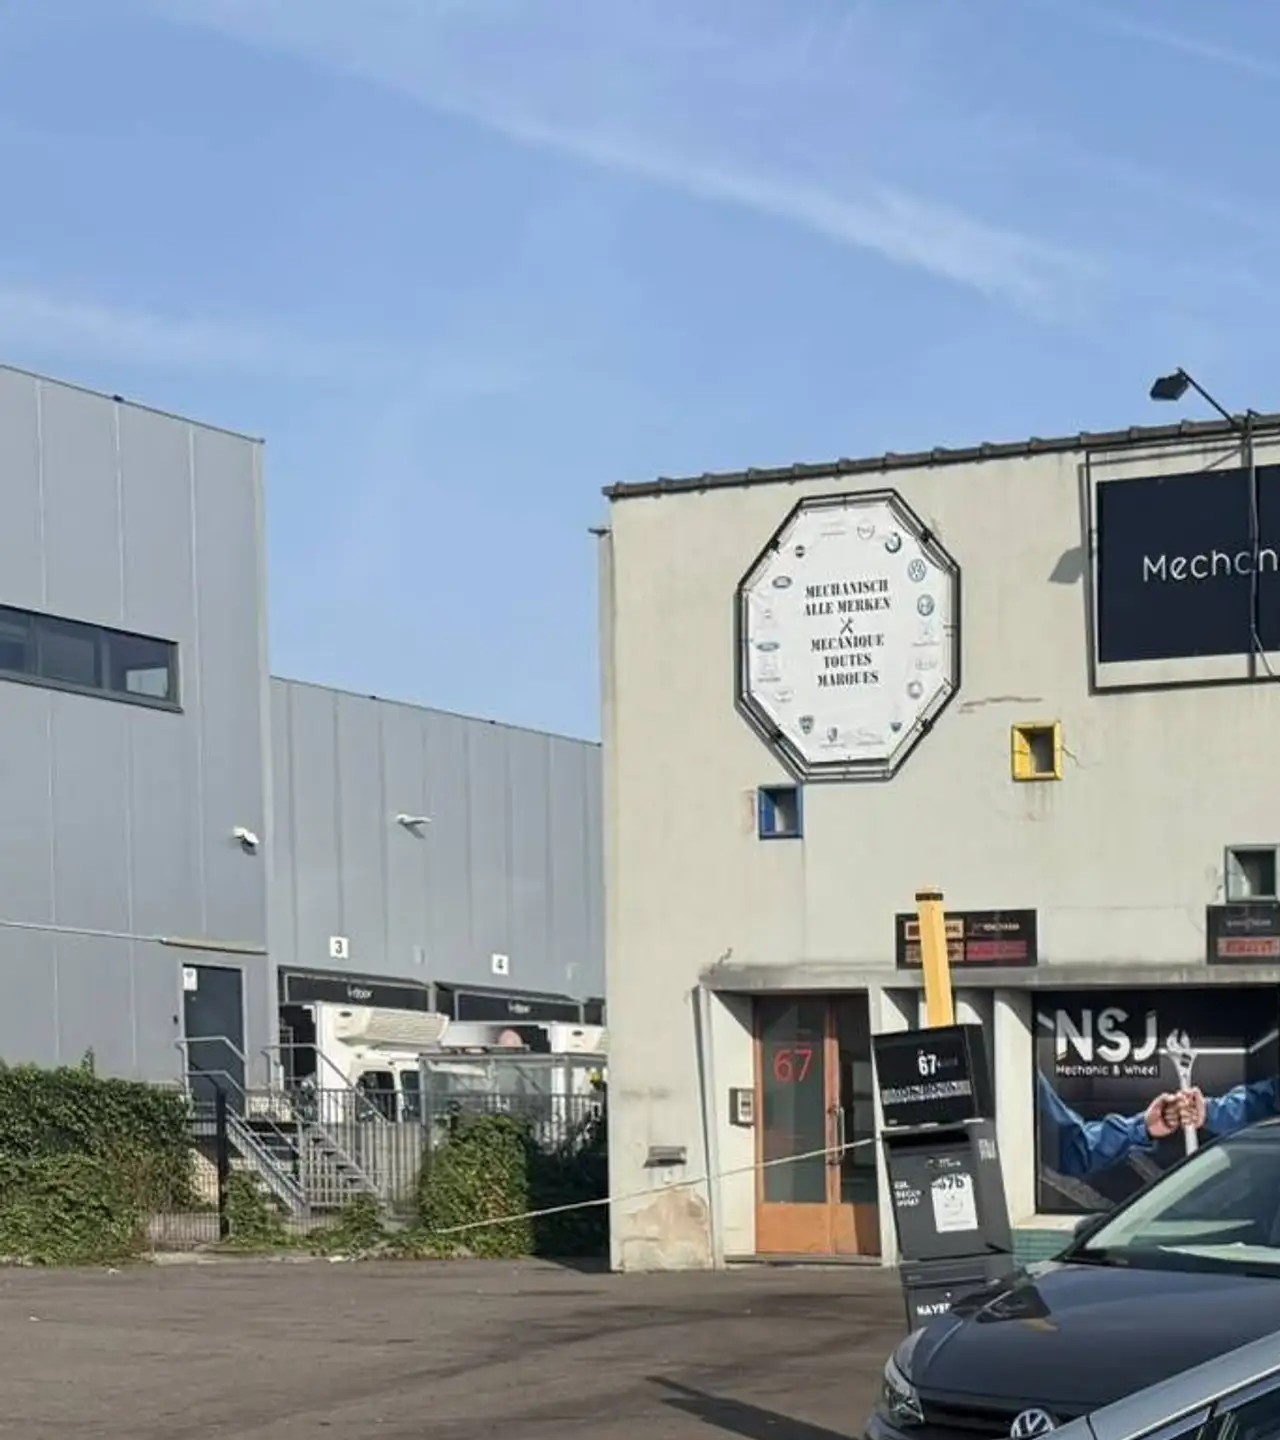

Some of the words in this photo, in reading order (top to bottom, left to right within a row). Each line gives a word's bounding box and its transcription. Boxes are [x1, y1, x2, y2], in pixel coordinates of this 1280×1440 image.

[805, 579, 889, 598] MECHANISCH
[803, 601, 834, 616] ALLE
[837, 597, 891, 612] MERKEN
[810, 634, 885, 652] MECANIQUE
[824, 653, 872, 669] TOUTES
[817, 670, 879, 687] MARQUES
[335, 940, 344, 954] 3
[1056, 1006, 1158, 1063] NSJ
[774, 1049, 813, 1082] 67
[918, 1054, 937, 1076] 67
